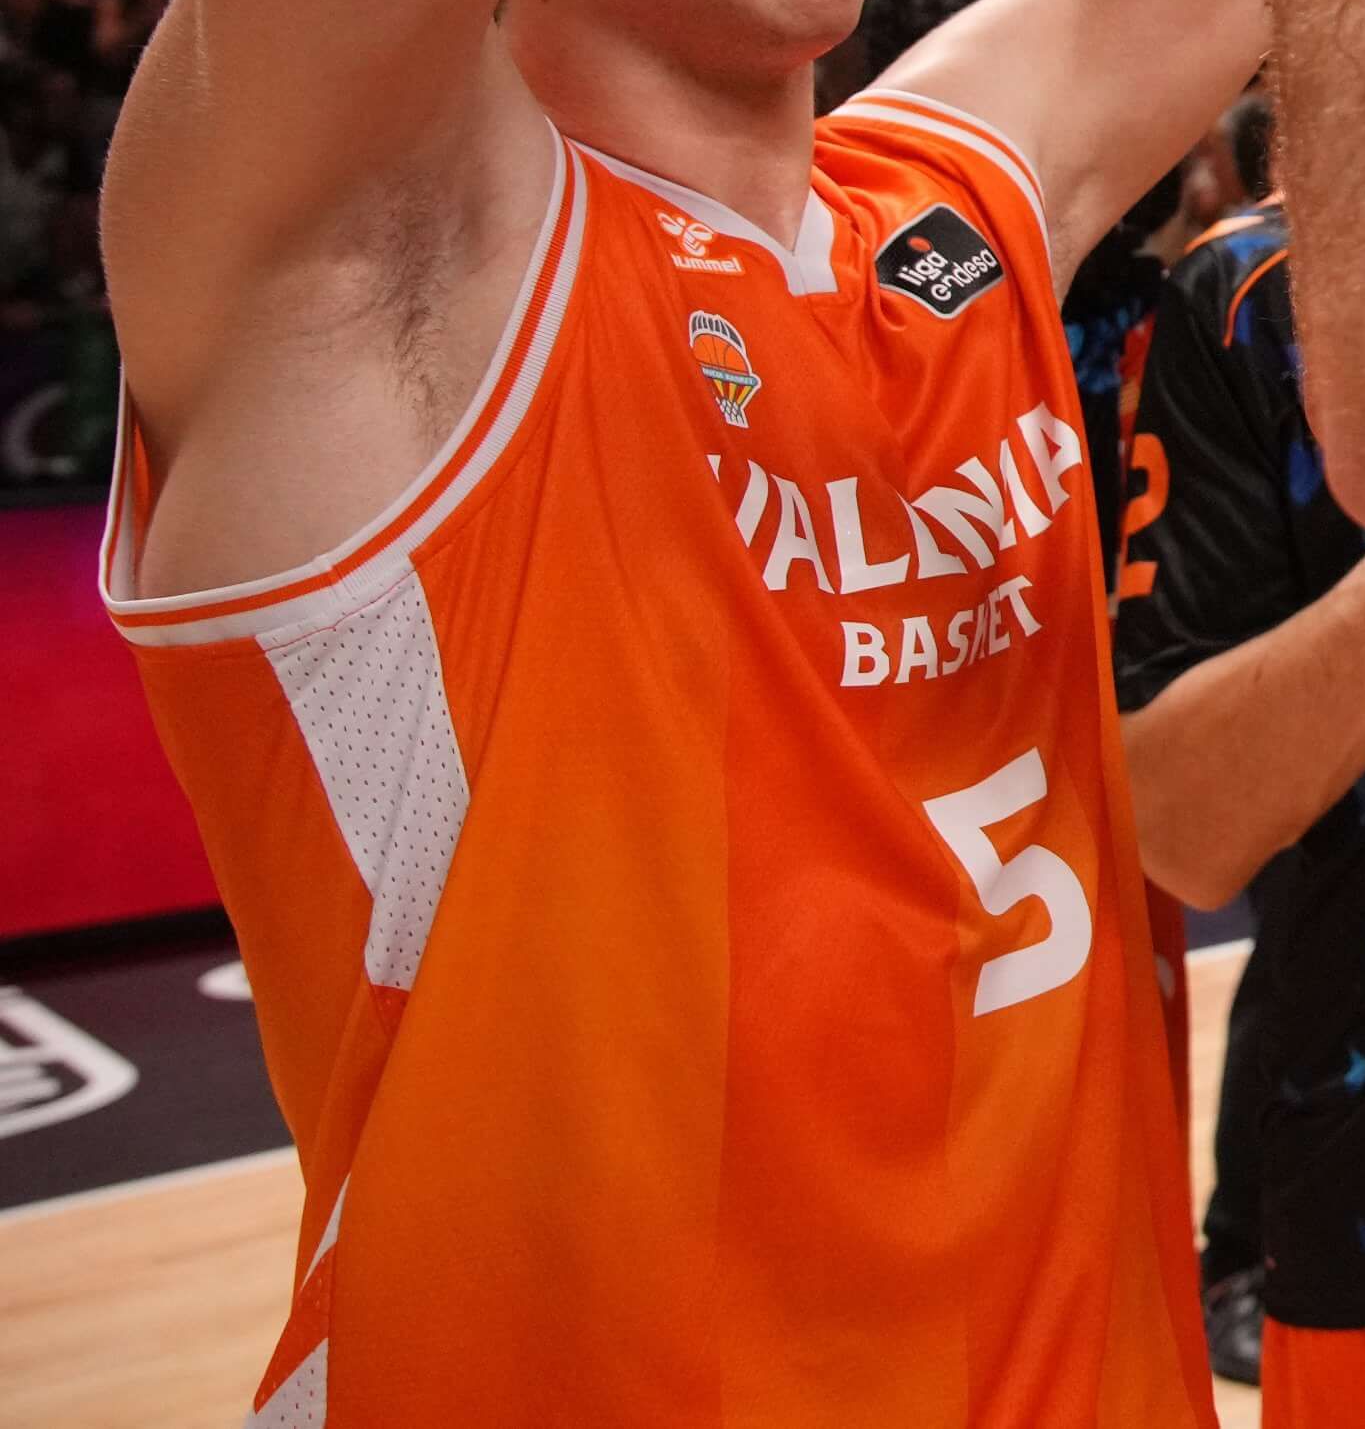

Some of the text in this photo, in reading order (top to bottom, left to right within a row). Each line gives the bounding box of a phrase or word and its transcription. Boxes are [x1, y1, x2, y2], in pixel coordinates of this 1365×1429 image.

[898, 251, 949, 287] liga
[930, 248, 998, 302] endesa
[922, 746, 1092, 1018] 5
